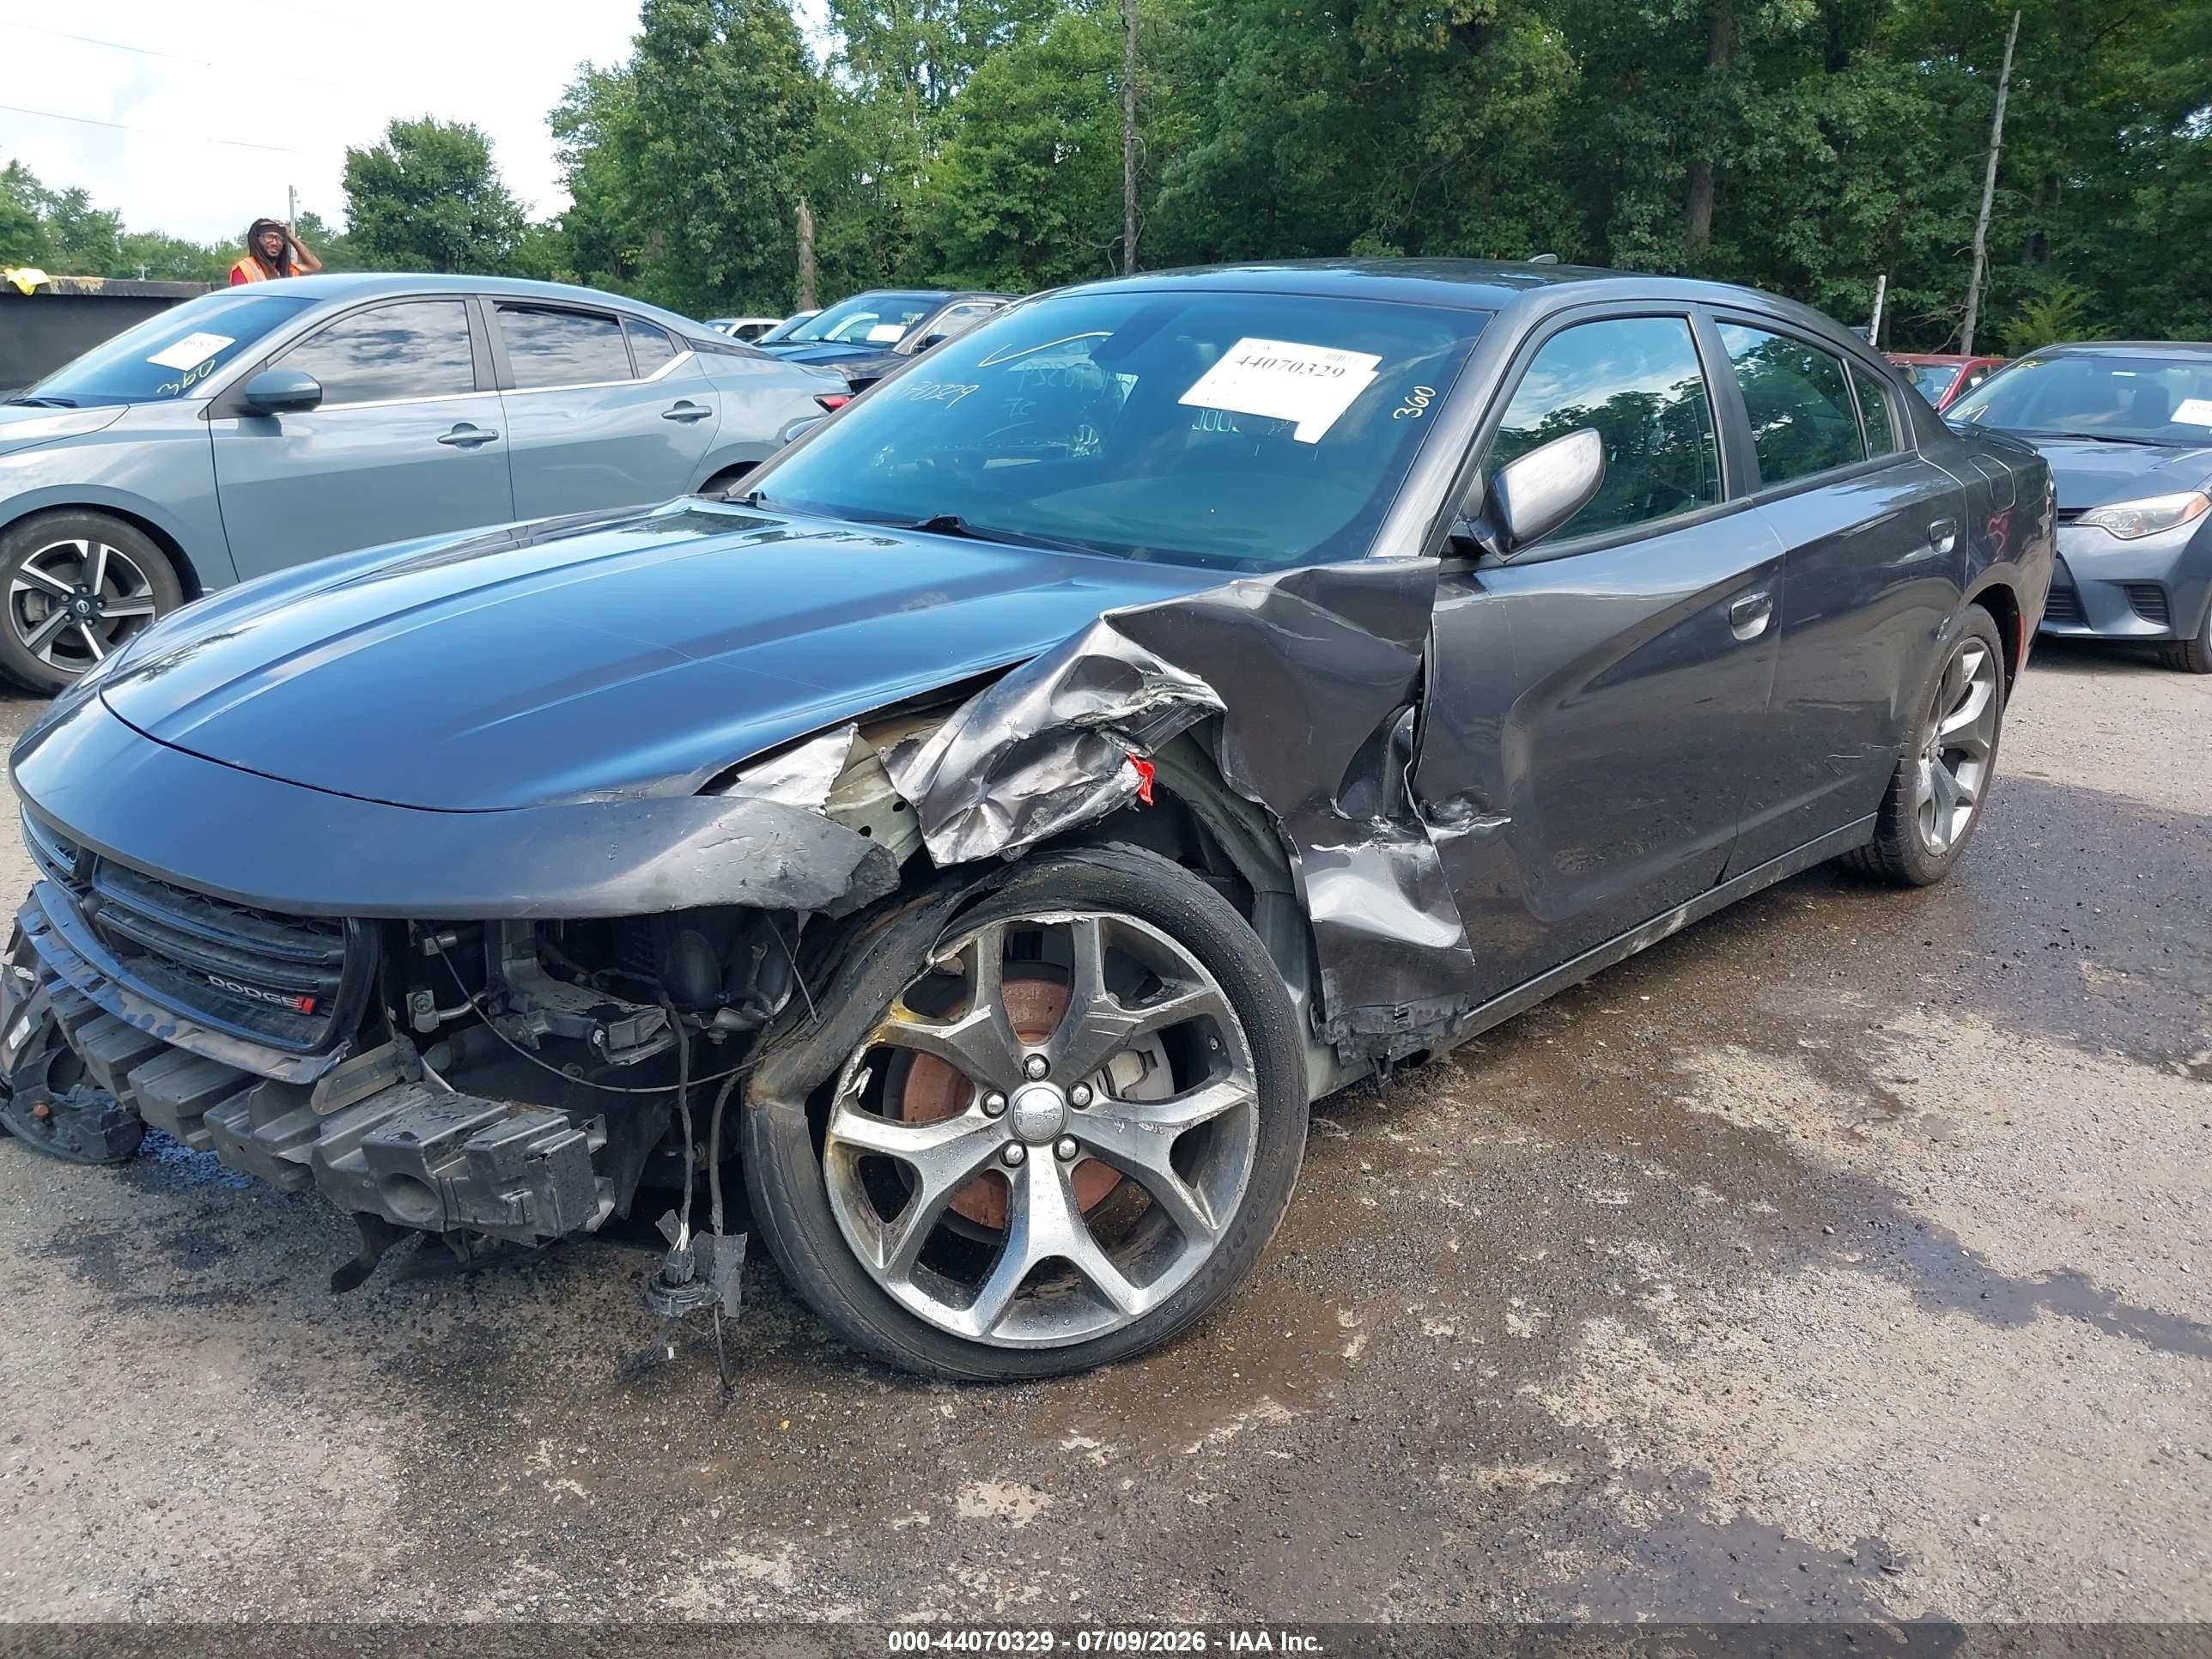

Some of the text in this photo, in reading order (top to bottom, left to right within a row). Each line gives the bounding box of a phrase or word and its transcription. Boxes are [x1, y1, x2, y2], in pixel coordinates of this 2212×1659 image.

[1236, 355, 1346, 378] 44070329
[1392, 385, 1437, 421] 360
[208, 975, 302, 1009] DODGE
